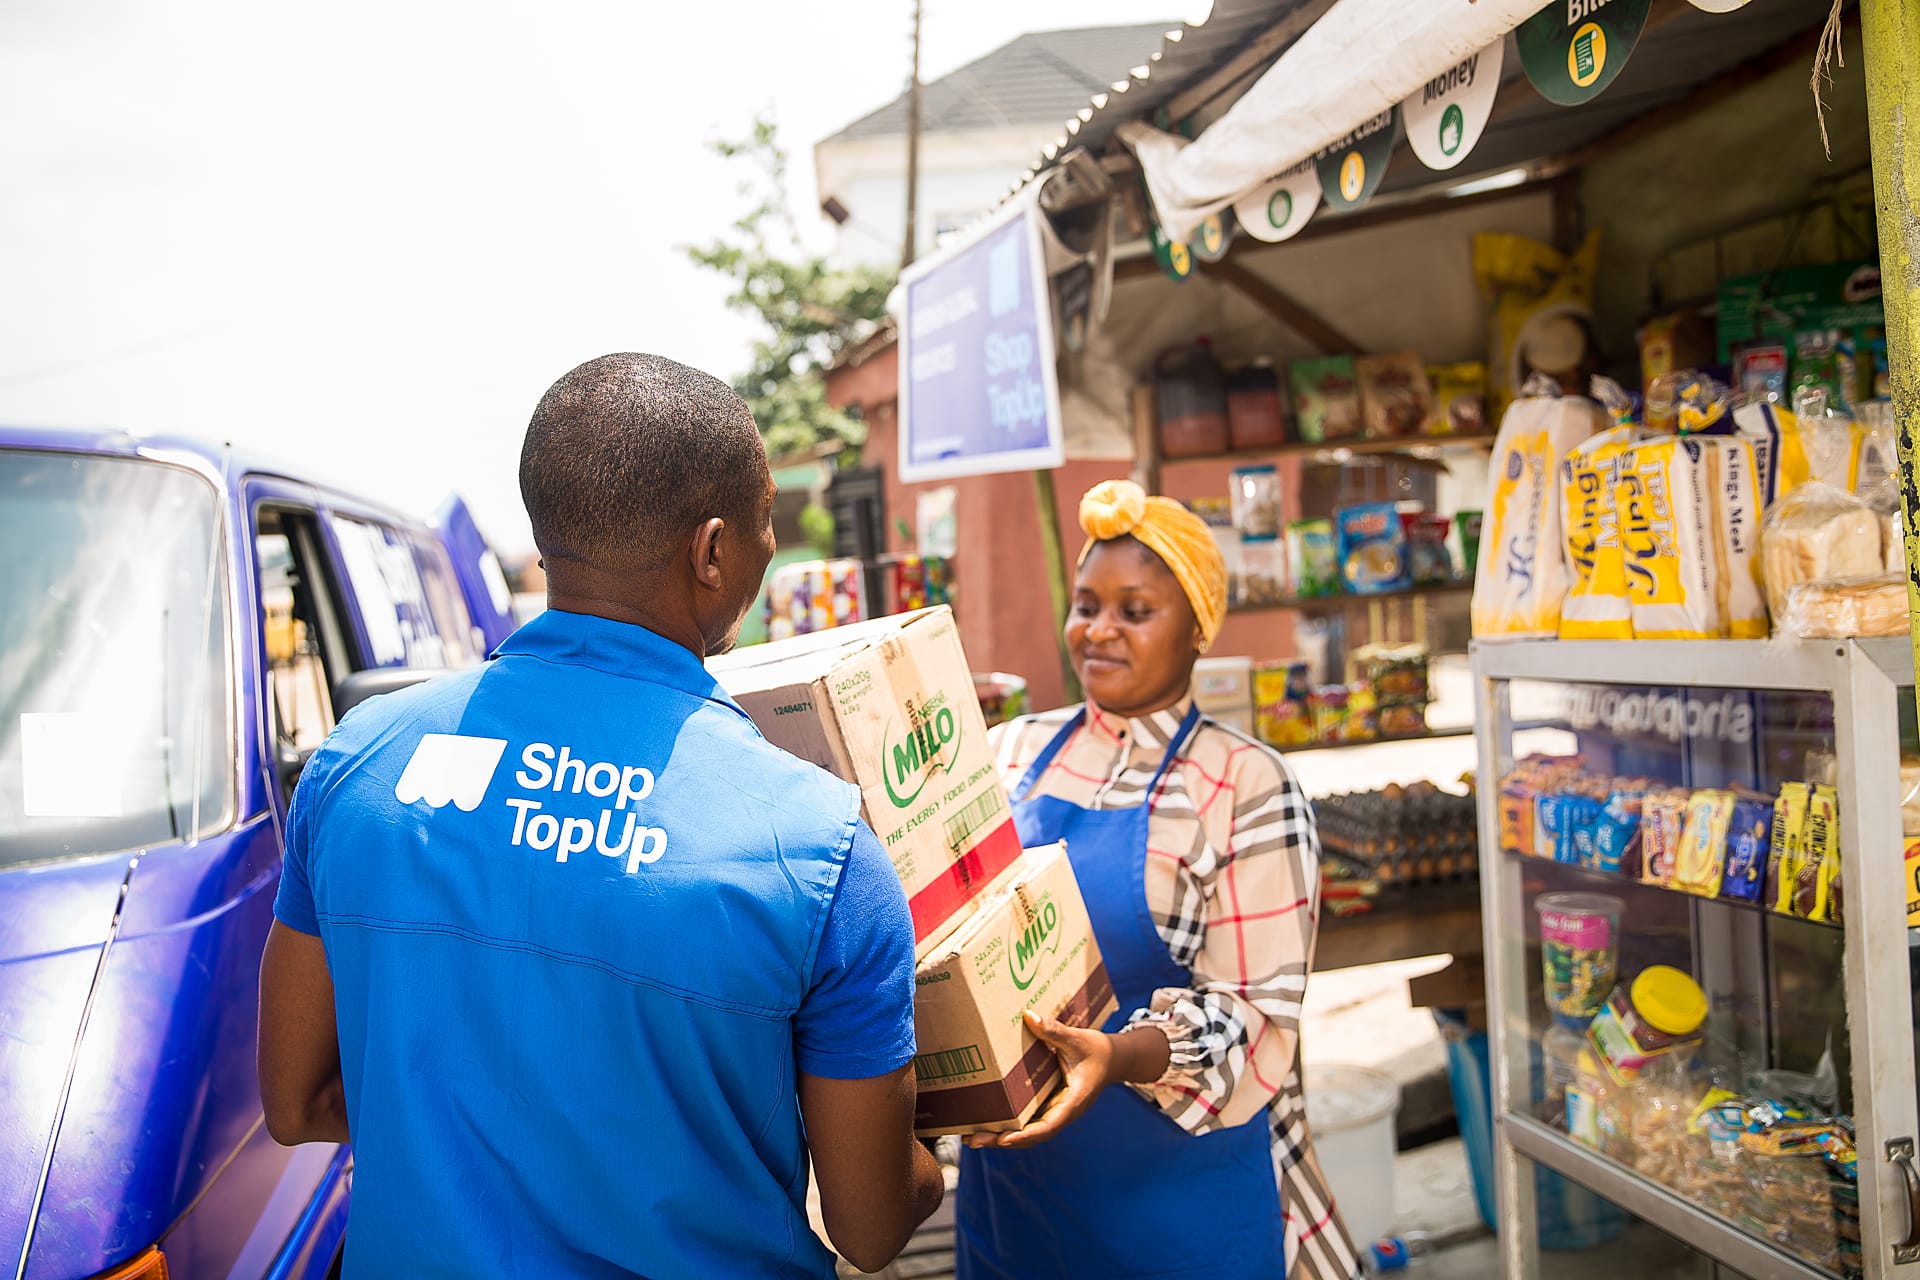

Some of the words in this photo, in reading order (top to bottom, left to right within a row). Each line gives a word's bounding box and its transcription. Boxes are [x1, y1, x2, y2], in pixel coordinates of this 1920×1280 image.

[1423, 52, 1479, 105] Money
[515, 742, 655, 810] Shop
[893, 706, 955, 785] MILO
[505, 798, 668, 875] TopUp
[885, 825, 905, 848] THE
[905, 800, 941, 833] ENERGY
[1015, 901, 1057, 972] MILO
